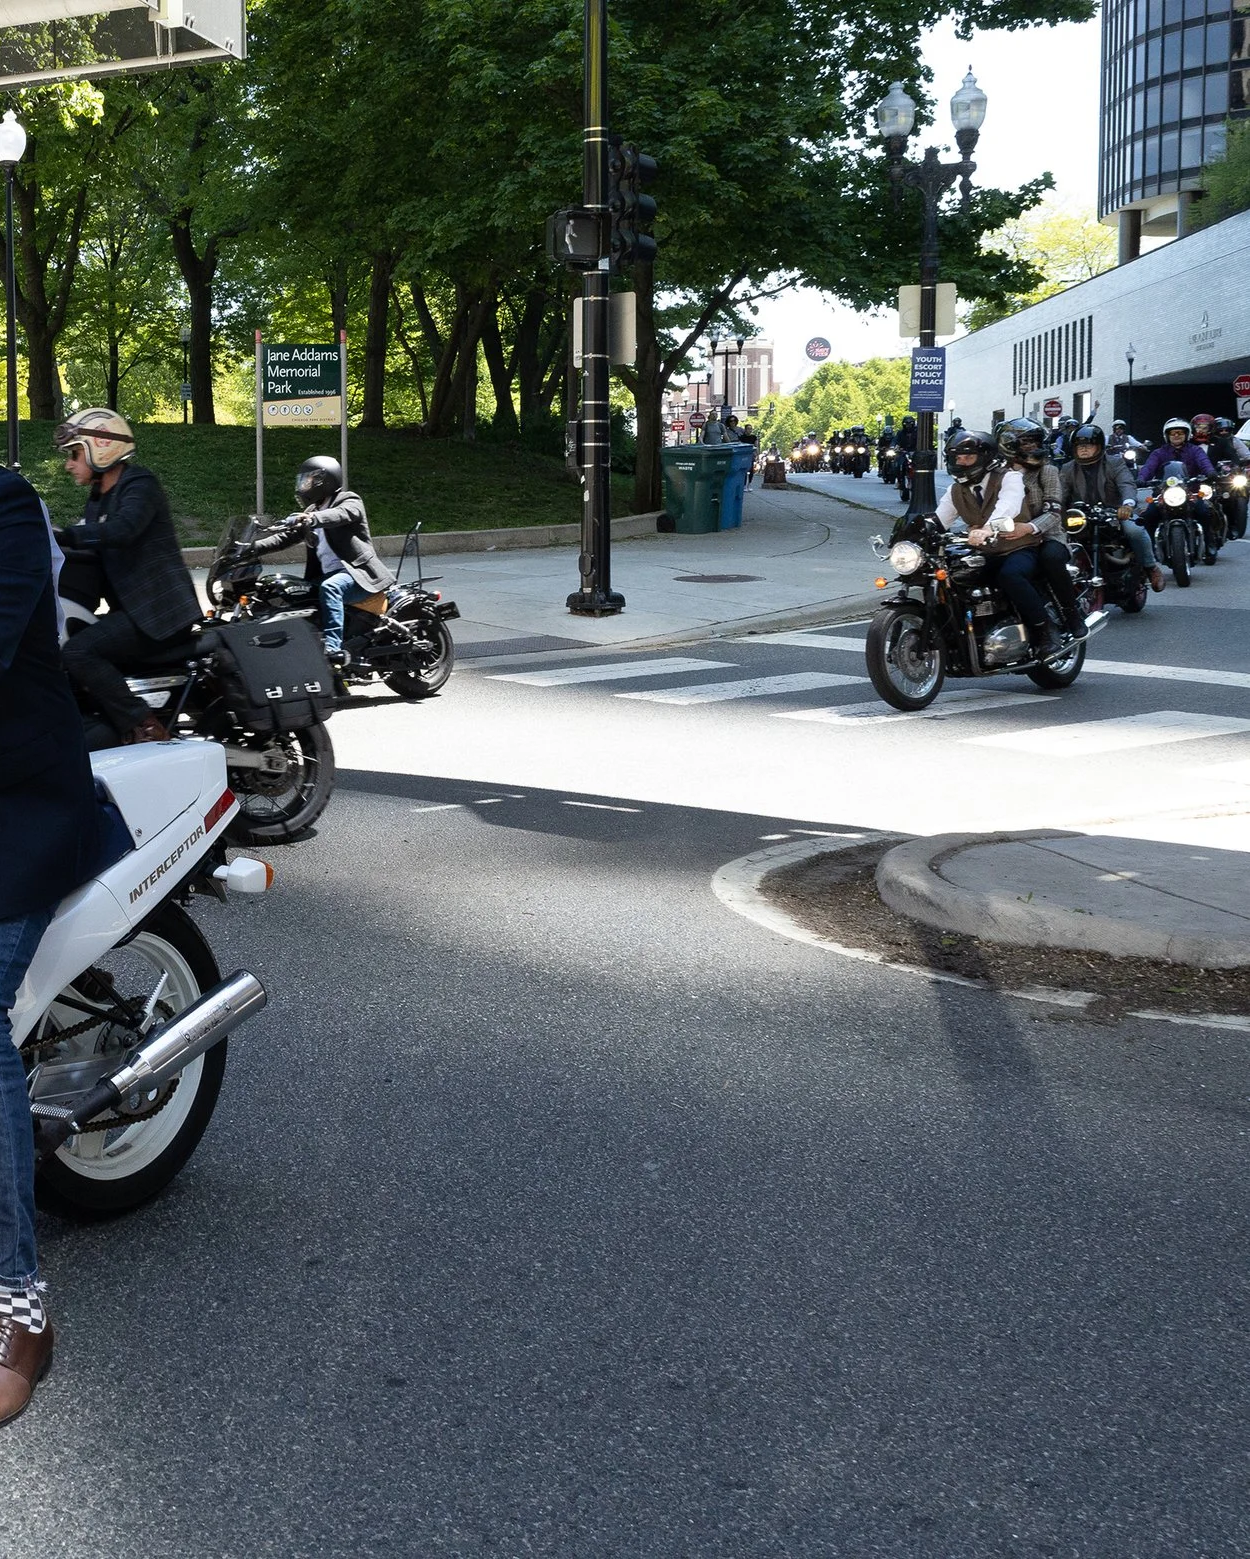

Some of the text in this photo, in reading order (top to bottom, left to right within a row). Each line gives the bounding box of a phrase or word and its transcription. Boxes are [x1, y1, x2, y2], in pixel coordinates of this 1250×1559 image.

[267, 347, 339, 364] Jane Addams
[267, 364, 321, 378] Memorial
[267, 381, 292, 394] Park
[325, 388, 336, 396] 1996
[1235, 381, 1250, 391] STO
[129, 825, 204, 905] INTERCEPTOR
